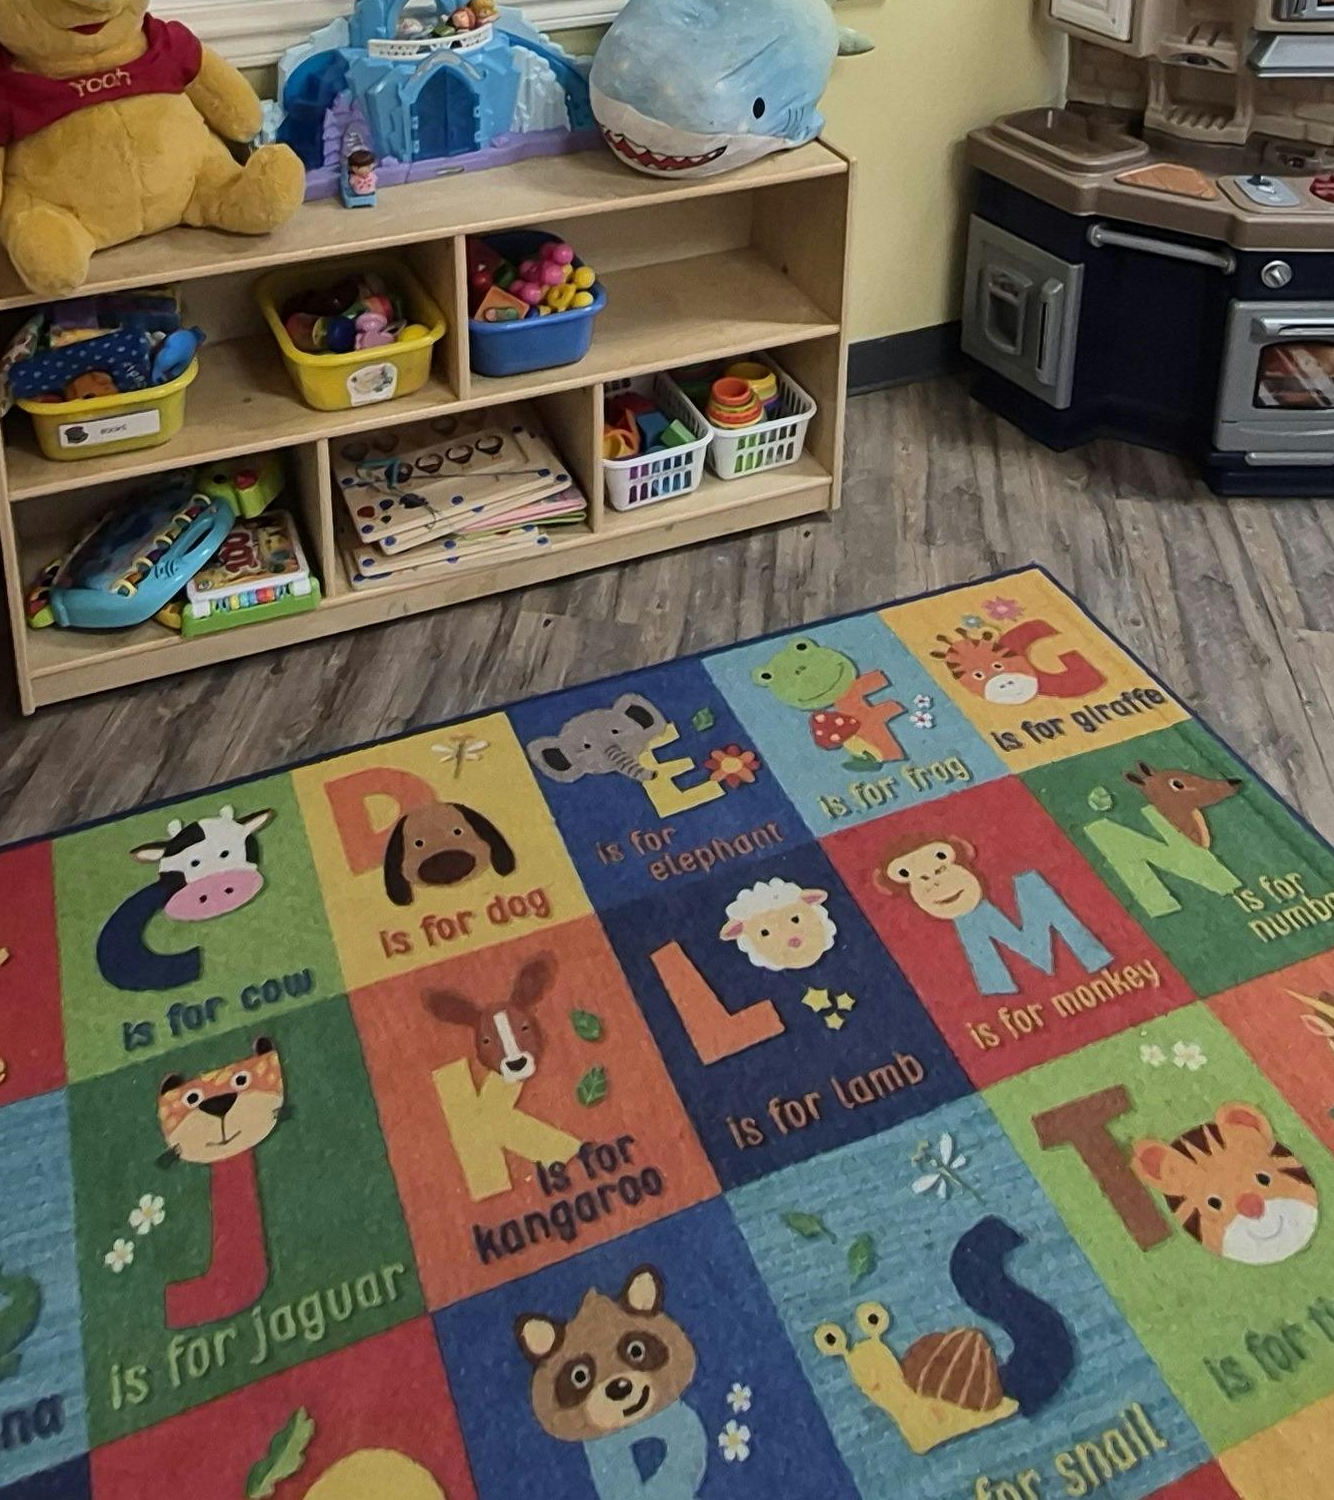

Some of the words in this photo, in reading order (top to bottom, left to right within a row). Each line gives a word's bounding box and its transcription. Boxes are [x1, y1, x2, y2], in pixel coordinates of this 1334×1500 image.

[990, 730, 1026, 752] is
[1020, 717, 1066, 745] for
[1070, 687, 1168, 733] giraffe
[819, 795, 851, 819] is
[849, 776, 900, 809] for
[901, 756, 974, 792] frog
[595, 840, 626, 866] is
[629, 826, 677, 857] for
[650, 821, 784, 881] elephant
[1082, 803, 1244, 919] N
[1232, 886, 1266, 913] is
[1258, 871, 1306, 904] for
[378, 928, 416, 959] is
[420, 908, 476, 948] for
[485, 887, 553, 926] dog
[953, 868, 1115, 996] M
[123, 1020, 156, 1052] is
[167, 995, 227, 1037] for
[240, 967, 313, 1012] cow
[649, 938, 787, 1067] L
[966, 1021, 1001, 1050] is
[997, 1003, 1045, 1041] for
[1050, 957, 1162, 1019] monkey
[431, 1057, 582, 1203] K
[725, 1115, 765, 1150] is
[767, 1090, 823, 1135] for
[829, 1050, 927, 1111] lamb
[534, 1158, 572, 1197] is
[577, 1133, 636, 1181] for
[1031, 1083, 1173, 1253] T
[472, 1165, 664, 1266] kangaroo
[107, 1362, 151, 1412] is
[166, 1324, 238, 1389] for
[249, 1261, 406, 1367] jaguar
[1202, 1354, 1254, 1400] is
[1243, 1321, 1308, 1383] for
[1053, 1400, 1167, 1497] snail
